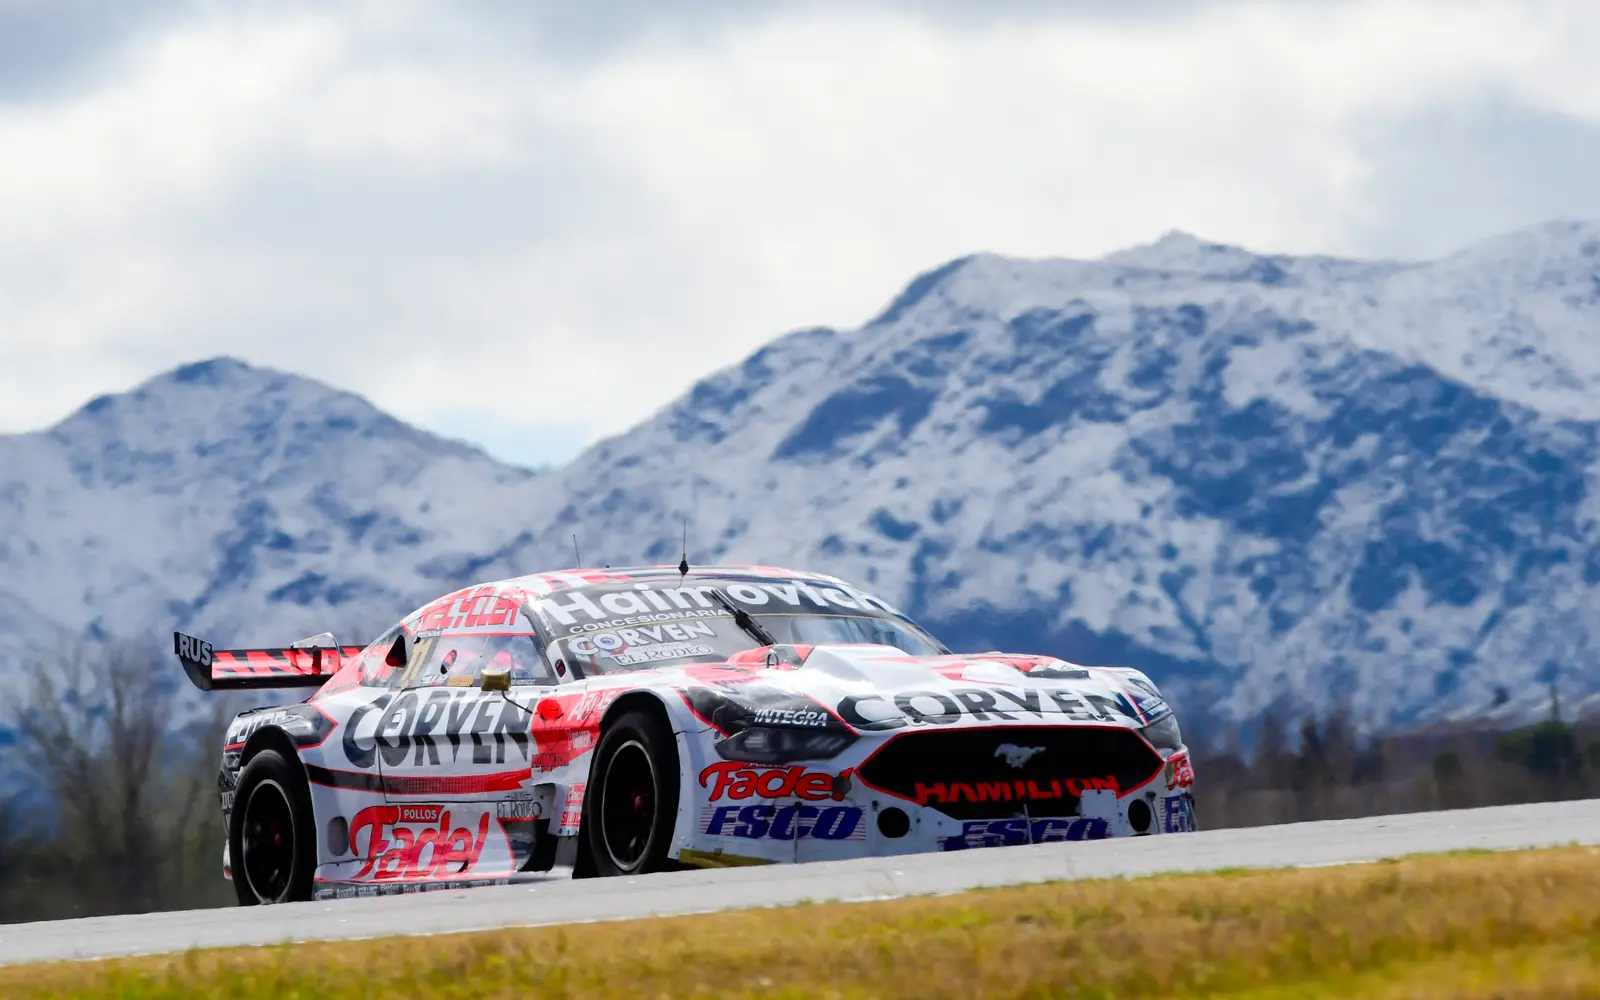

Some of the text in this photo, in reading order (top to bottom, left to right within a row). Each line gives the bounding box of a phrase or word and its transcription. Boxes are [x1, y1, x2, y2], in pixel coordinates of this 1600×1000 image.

[543, 579, 903, 625] Haimovich
[568, 620, 716, 655] CORVEN
[569, 609, 735, 635] CONCESIONARIA
[179, 634, 212, 666] RUS
[644, 645, 712, 661] RODEO
[754, 706, 828, 727] INTEGRA
[837, 687, 1124, 730] CORVEN
[343, 690, 539, 769] CORVEN
[403, 808, 438, 821] POLLOS
[705, 805, 863, 840] ESCO
[349, 805, 490, 879] Fadel
